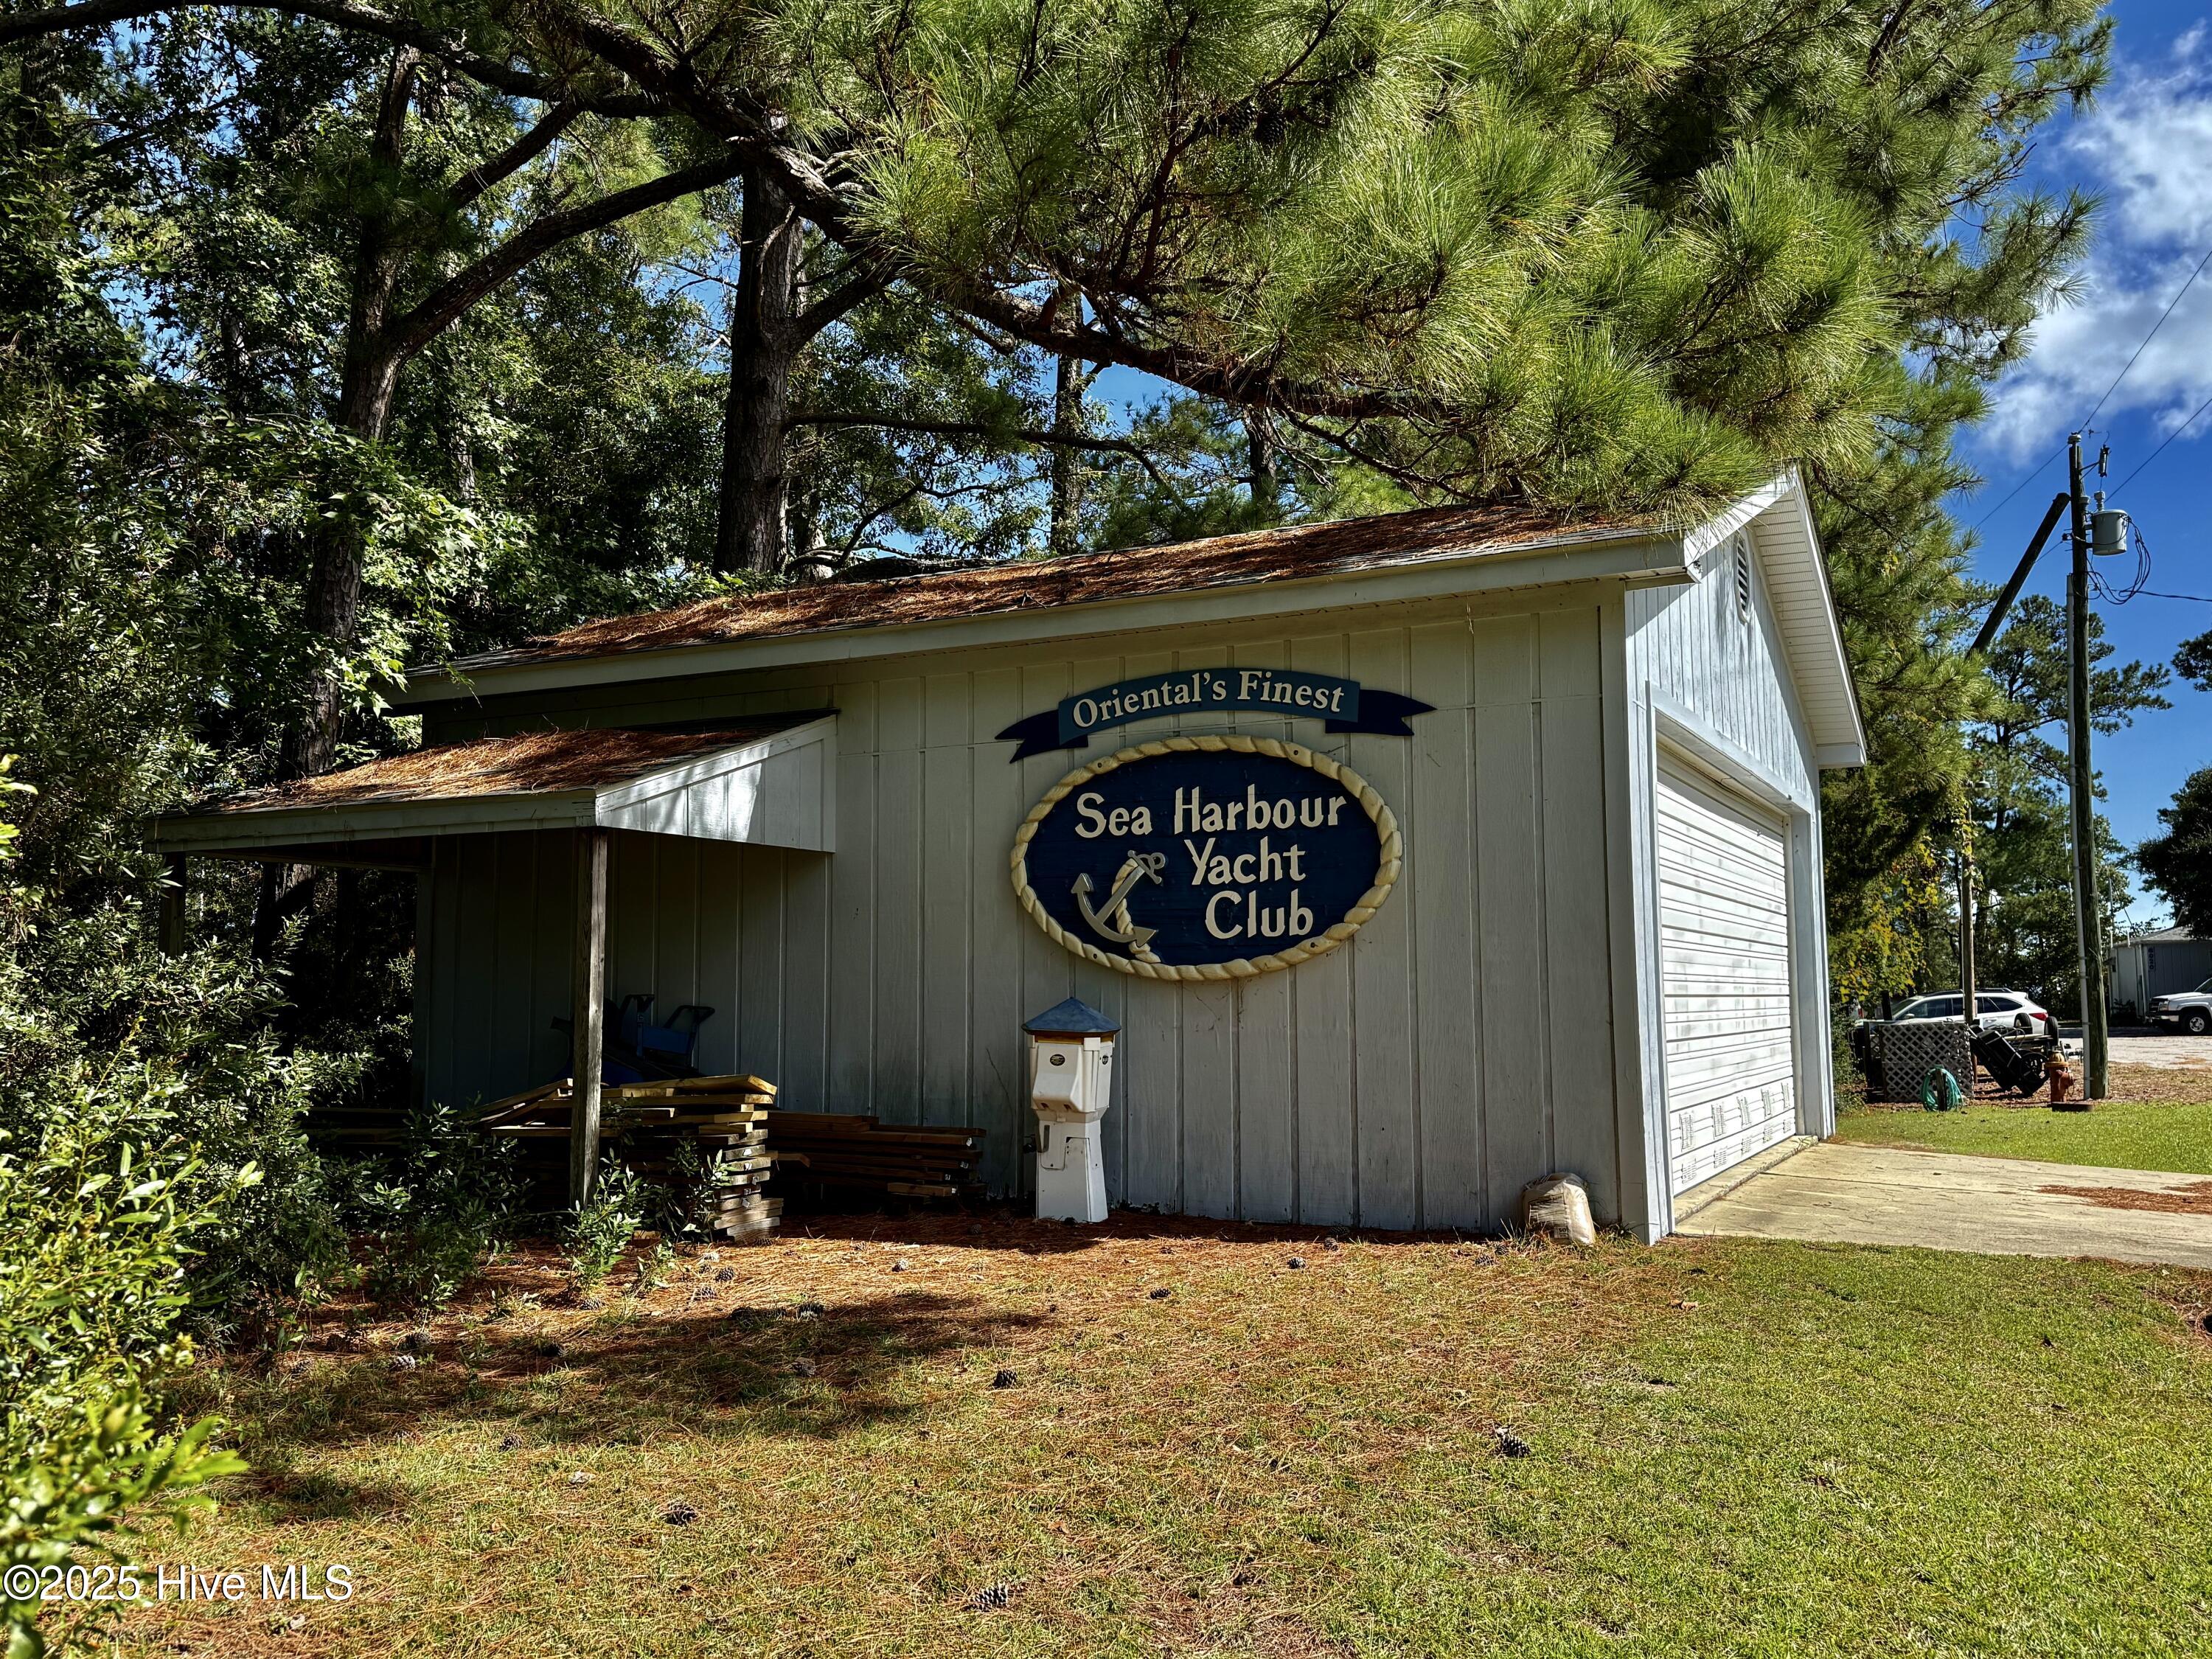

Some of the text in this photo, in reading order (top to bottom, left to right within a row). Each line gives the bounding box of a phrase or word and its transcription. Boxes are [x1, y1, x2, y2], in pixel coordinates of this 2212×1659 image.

[1237, 671, 1345, 712] Finest
[1075, 783, 1347, 838] Sea Harbour
[1184, 836, 1307, 886] Yacht
[1206, 888, 1314, 939] Club
